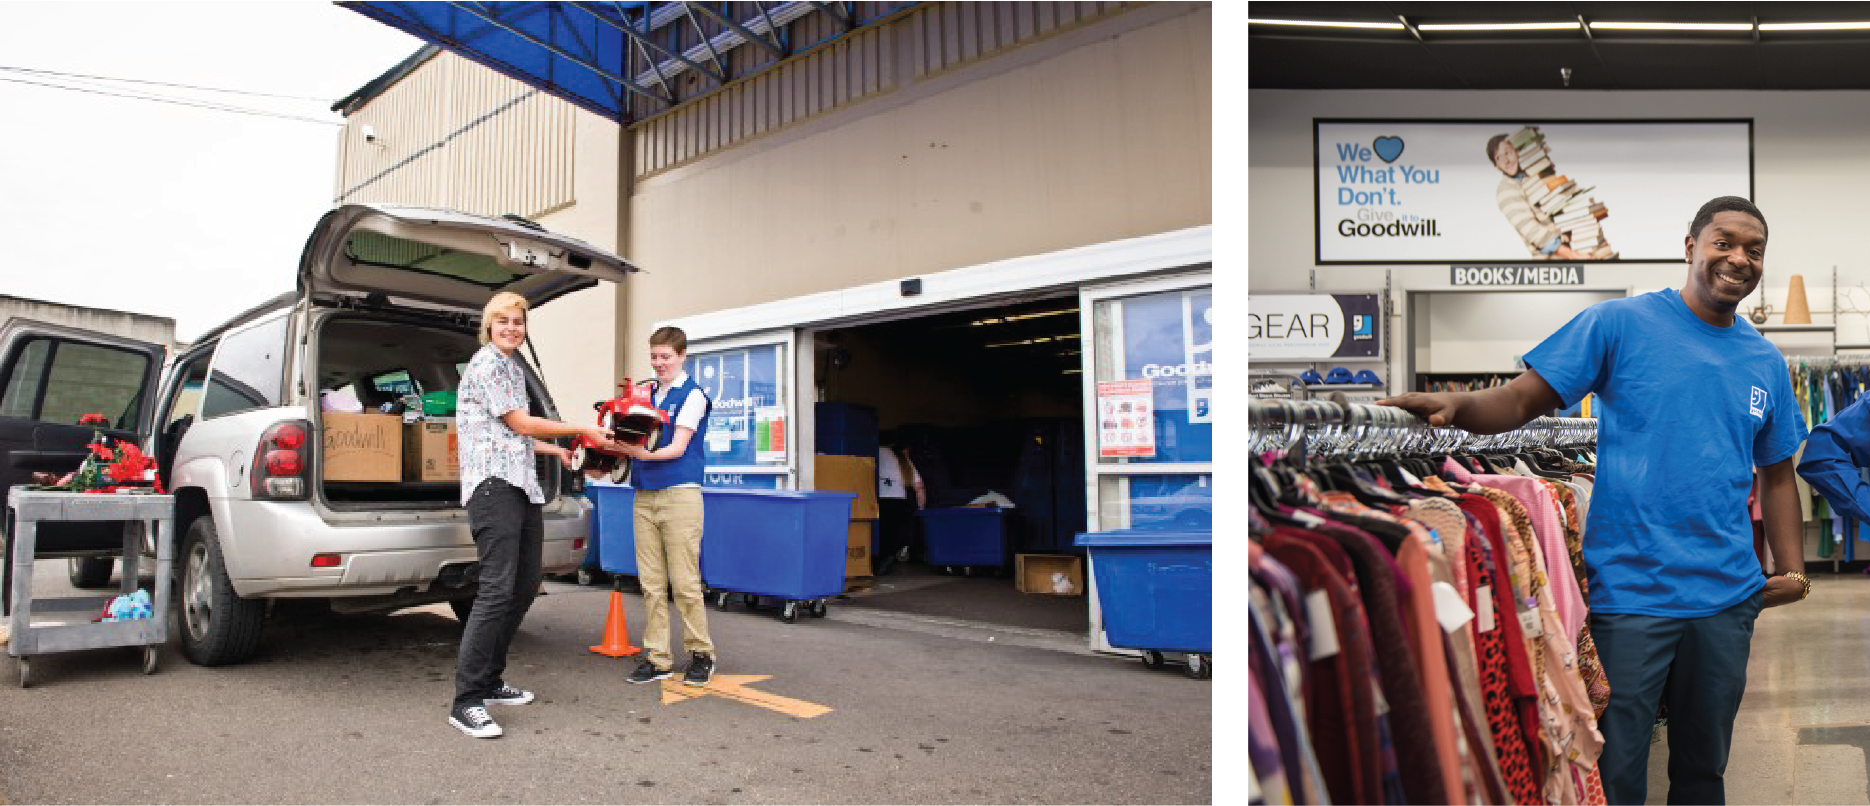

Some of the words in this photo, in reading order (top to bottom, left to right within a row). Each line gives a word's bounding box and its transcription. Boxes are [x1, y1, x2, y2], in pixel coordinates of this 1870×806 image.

[1336, 142, 1372, 162] We
[1336, 164, 1396, 184] What
[1398, 164, 1440, 184] You
[1338, 186, 1402, 206] Don't.
[1356, 207, 1394, 222] Give
[1402, 213, 1407, 222] it
[1410, 213, 1420, 222] to
[1337, 218, 1442, 237] Goodwill.
[1455, 266, 1579, 285] BOOKS/MEDIA
[1248, 313, 1330, 339] GEAR
